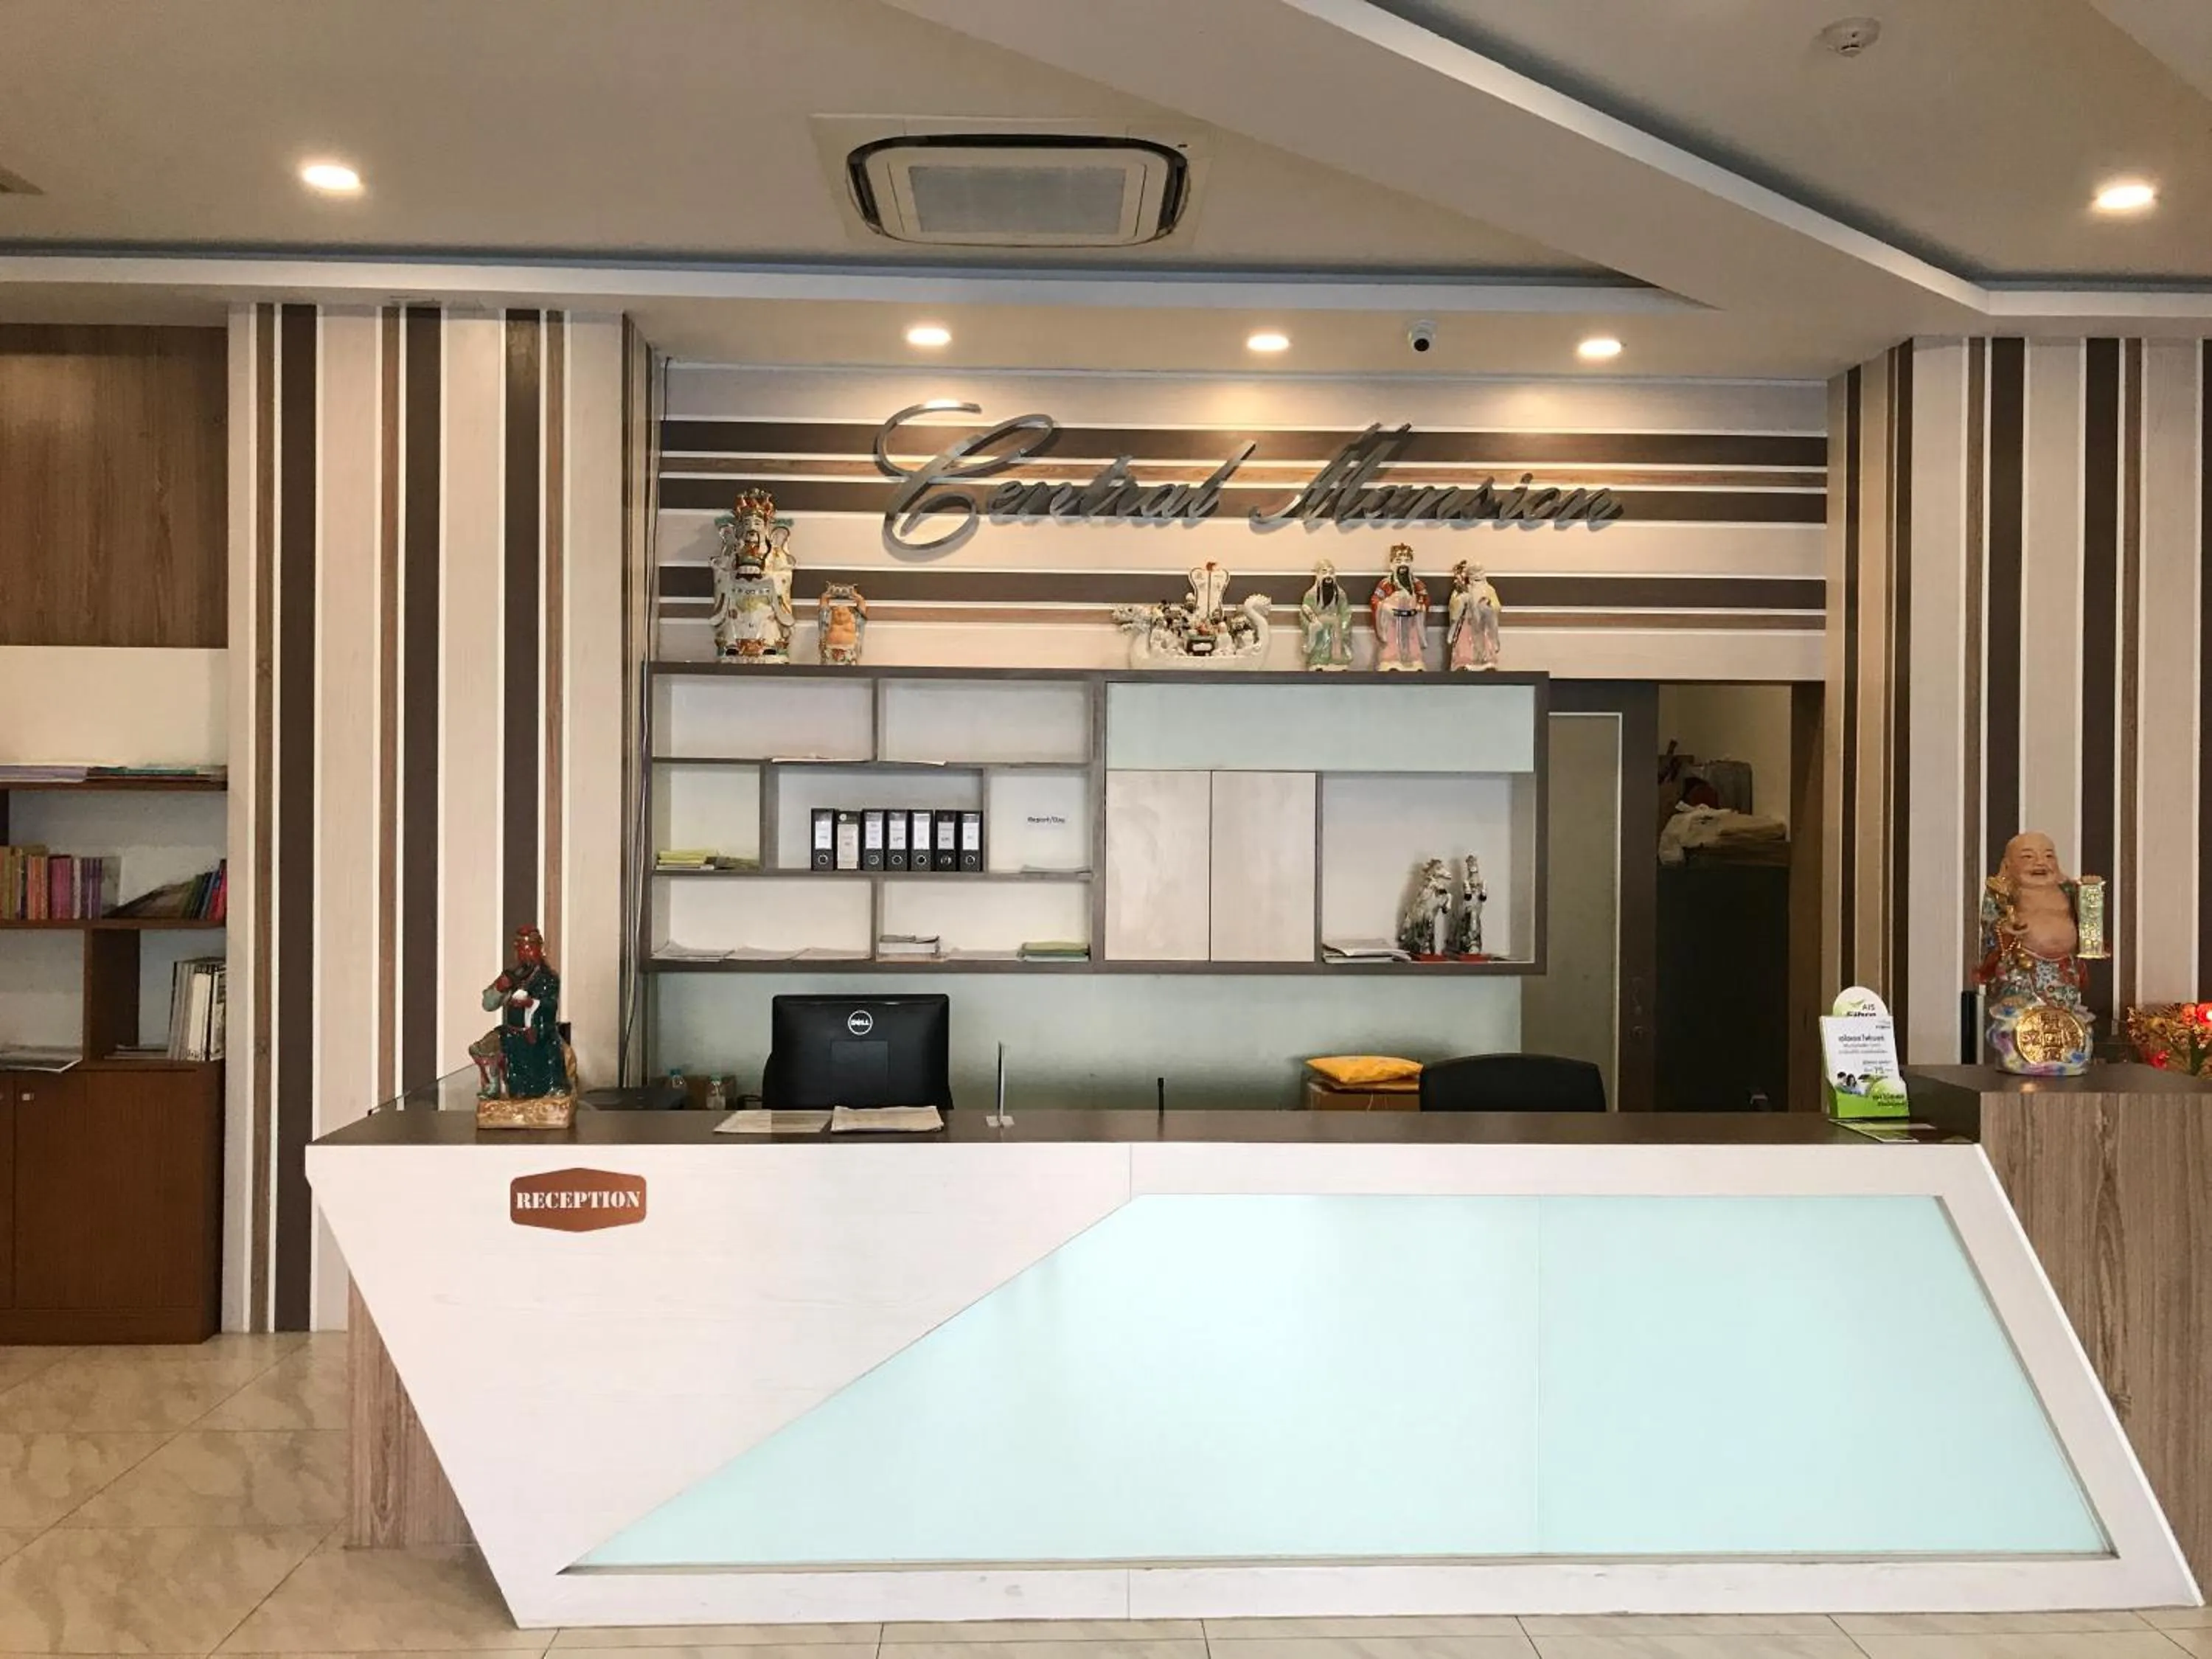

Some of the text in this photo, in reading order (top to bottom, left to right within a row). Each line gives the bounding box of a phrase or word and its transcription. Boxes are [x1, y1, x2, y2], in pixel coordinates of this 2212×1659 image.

[877, 403, 1624, 550] Central Mansion
[850, 1018, 870, 1026] DELL
[516, 1191, 641, 1209] RECEPTION
